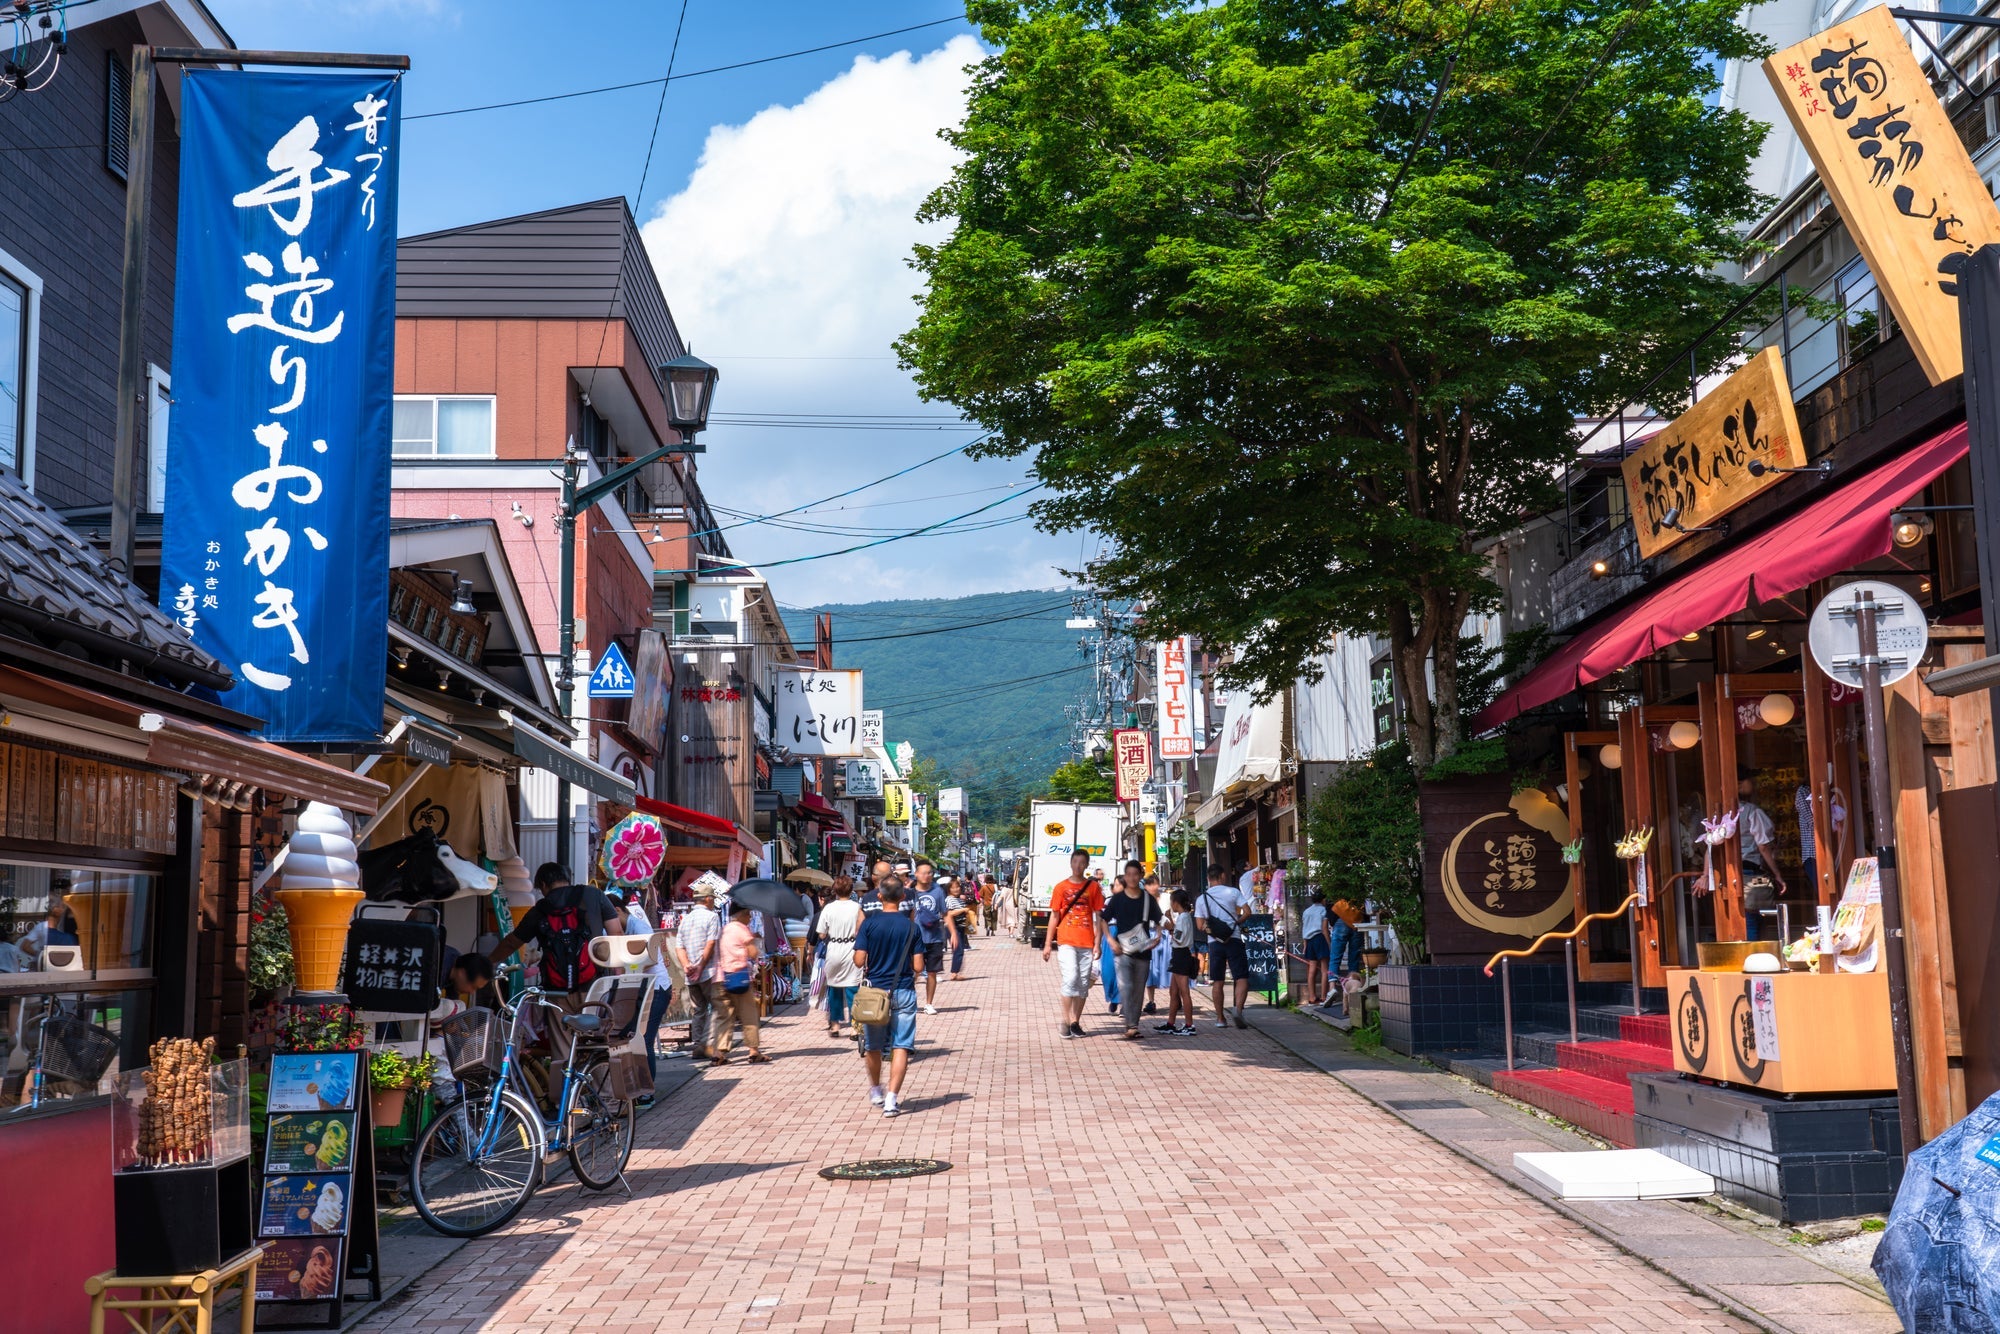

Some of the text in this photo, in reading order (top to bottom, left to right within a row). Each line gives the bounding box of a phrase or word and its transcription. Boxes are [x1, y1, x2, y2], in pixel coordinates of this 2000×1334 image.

[1786, 62, 1826, 117] 軽井沢
[227, 115, 351, 691] 手造りおかき
[202, 541, 221, 608] おかき処
[784, 679, 837, 694] そば処
[793, 713, 856, 745] にし川
[1120, 734, 1146, 745] 信州の
[1121, 744, 1146, 765] 酒
[1129, 768, 1147, 776] ワイン
[1049, 845, 1072, 853] クール
[1484, 840, 1504, 909] しゃぼん
[359, 943, 424, 967] 軽井沢
[355, 967, 422, 991] 物産館
[280, 1063, 308, 1073] ソーダ
